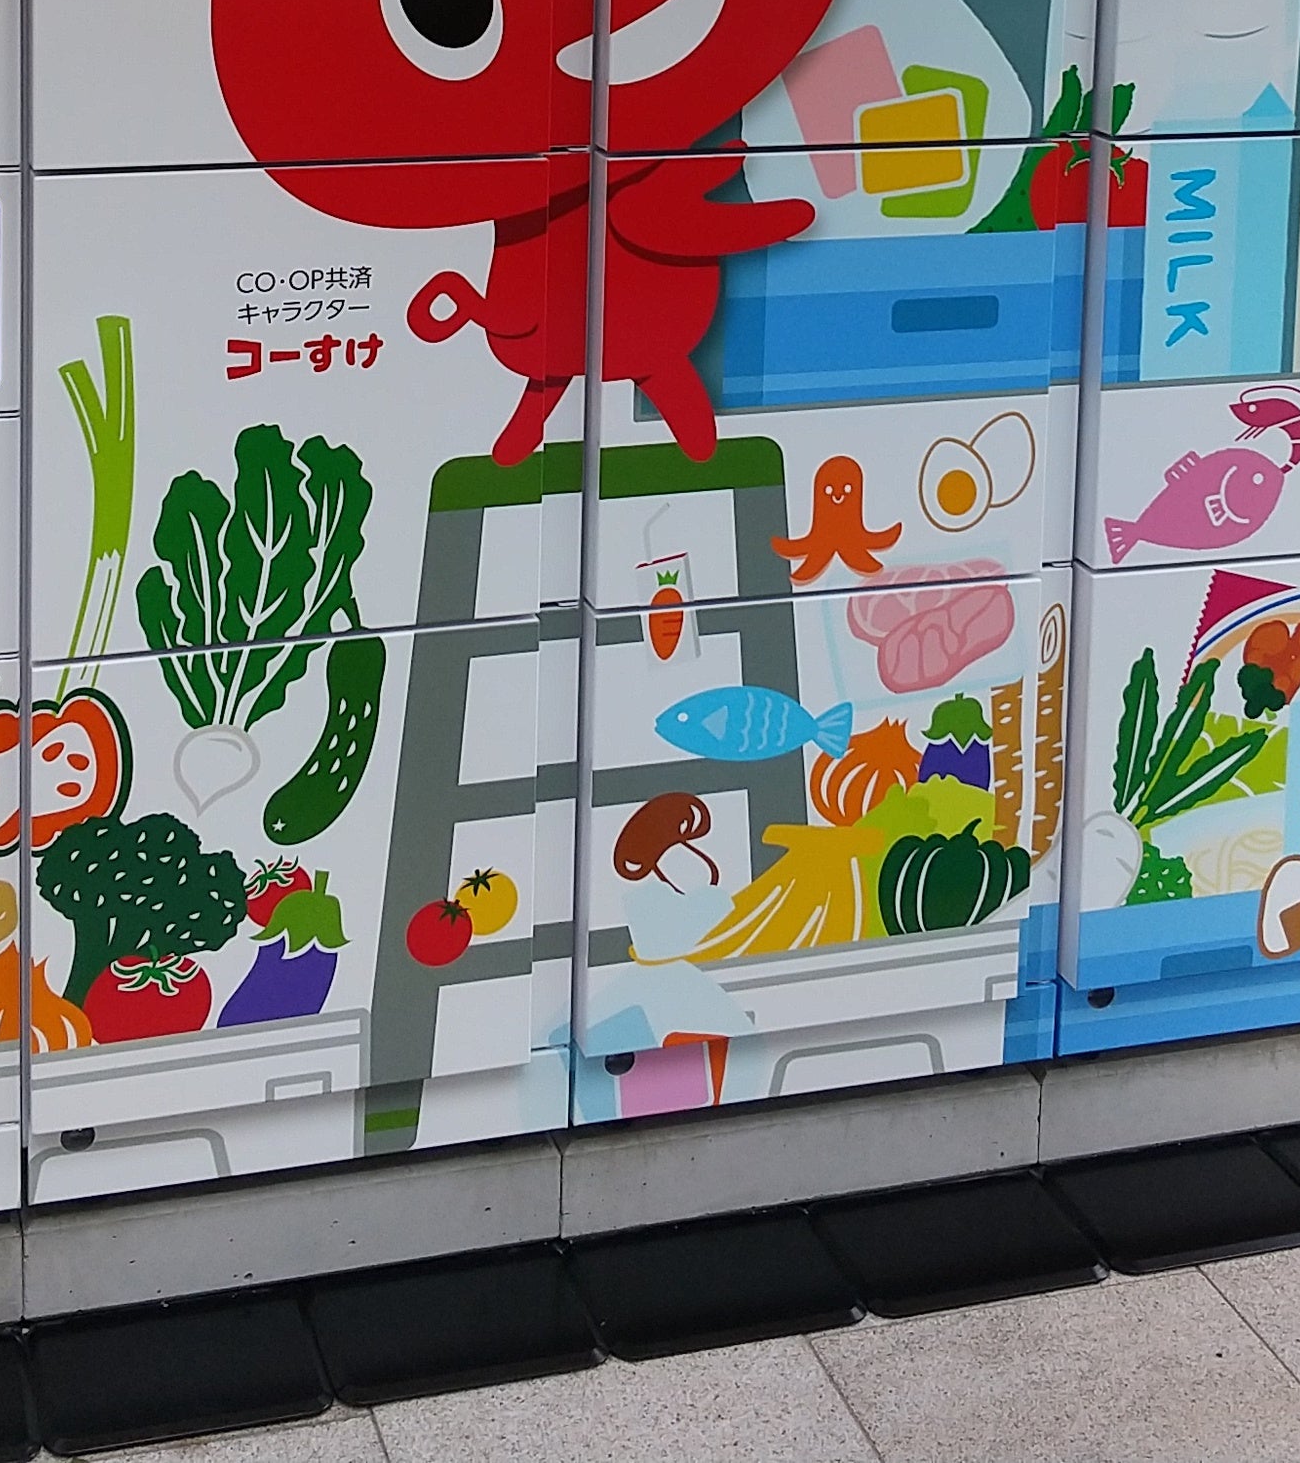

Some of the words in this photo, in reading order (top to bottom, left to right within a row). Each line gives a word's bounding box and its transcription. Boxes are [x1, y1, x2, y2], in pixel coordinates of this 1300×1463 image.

[1165, 168, 1217, 348] MILK
[237, 299, 370, 325] キャラクター
[226, 333, 384, 380] コーすけ
